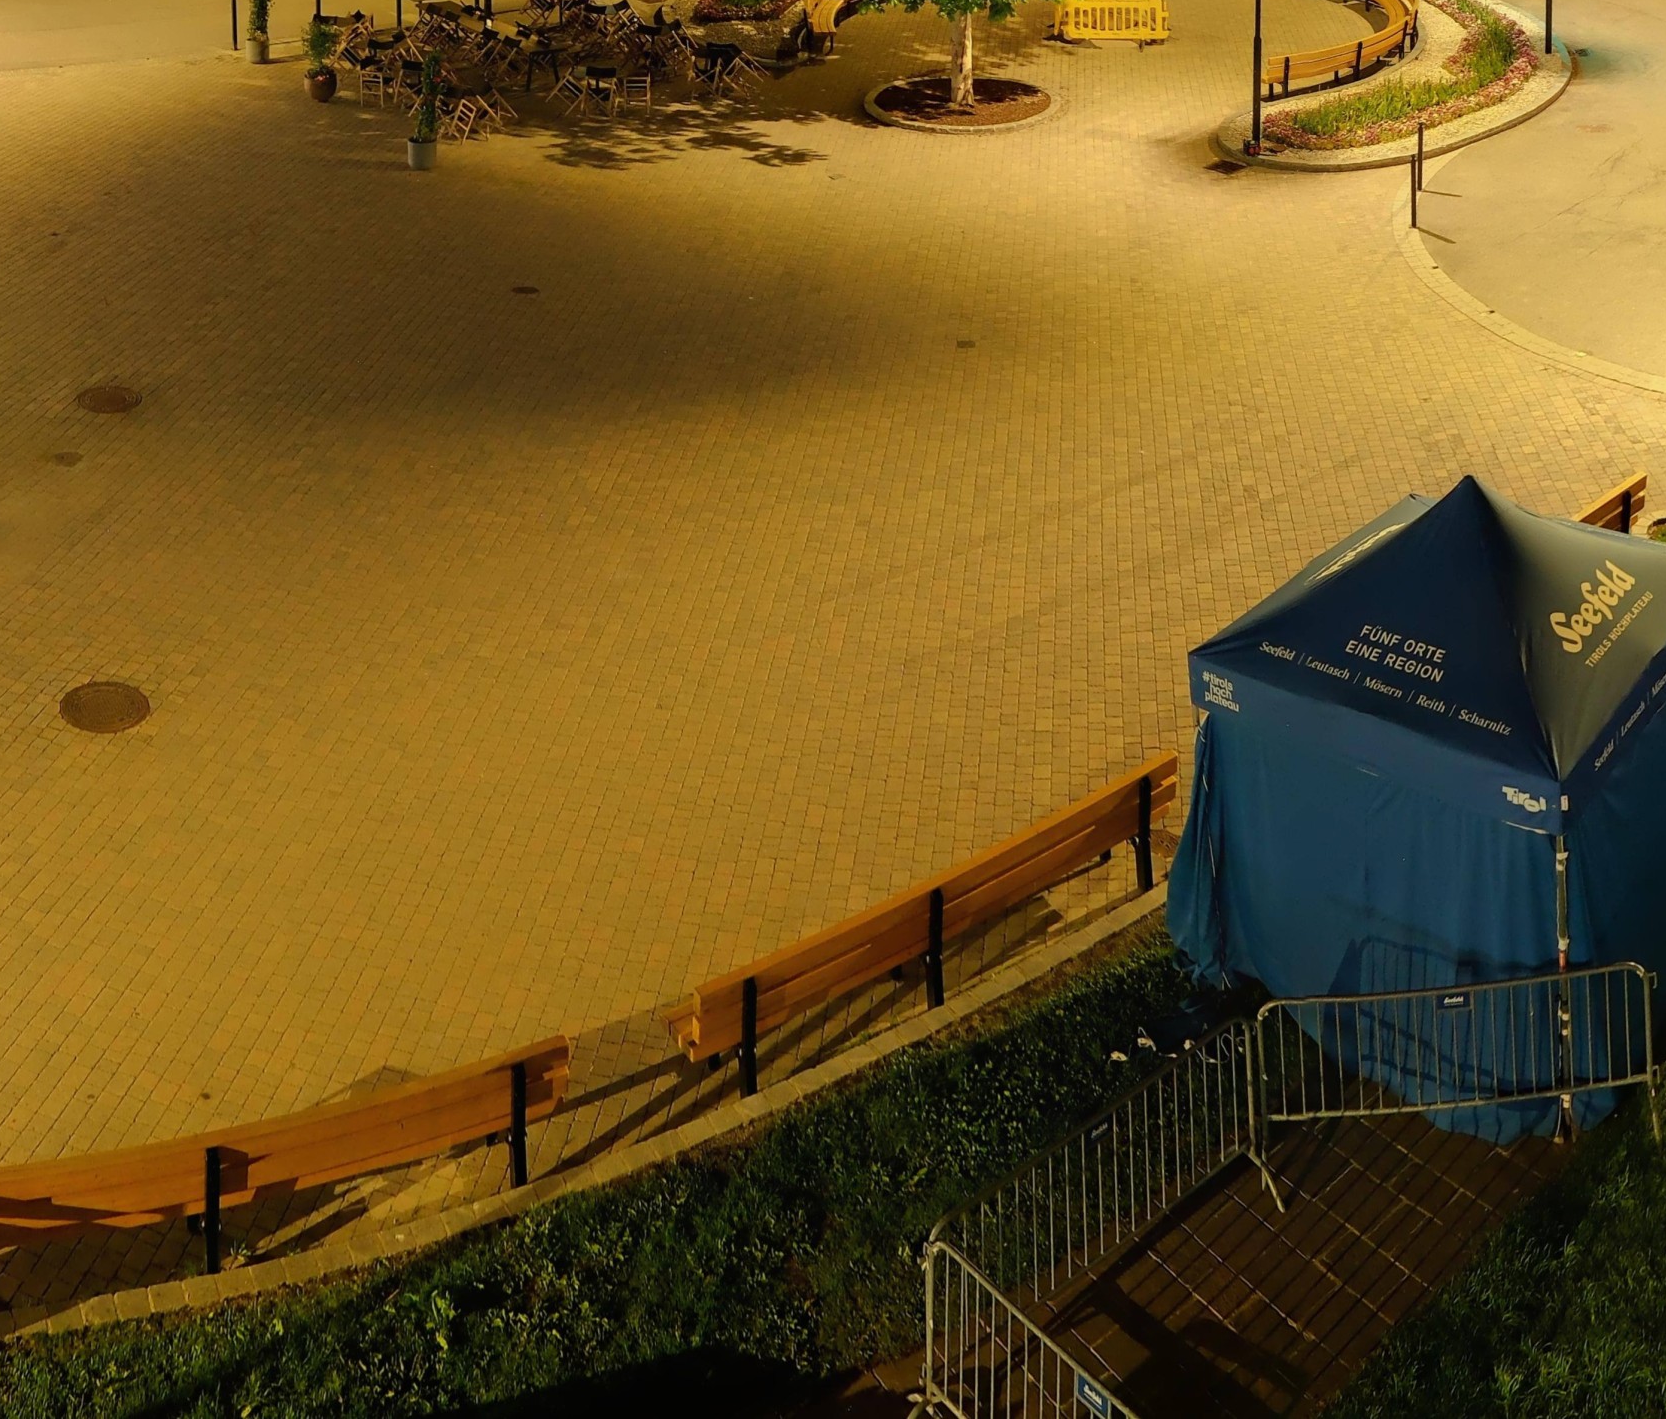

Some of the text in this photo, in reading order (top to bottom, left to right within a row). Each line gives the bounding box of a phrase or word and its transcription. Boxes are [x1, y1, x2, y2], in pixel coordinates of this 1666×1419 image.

[1550, 559, 1636, 654] Seefeld
[1360, 624, 1446, 663] FÜNF ORTE
[1585, 591, 1654, 668] TIROLS HOCHPLATEAU
[1202, 670, 1233, 691] #tirols
[1345, 640, 1444, 683] EINE REGION
[1205, 691, 1240, 713] plateau
[1209, 682, 1233, 701] hoch
[1259, 641, 1512, 736] Seefeld Leutasch Mösern Reith Scharnitz
